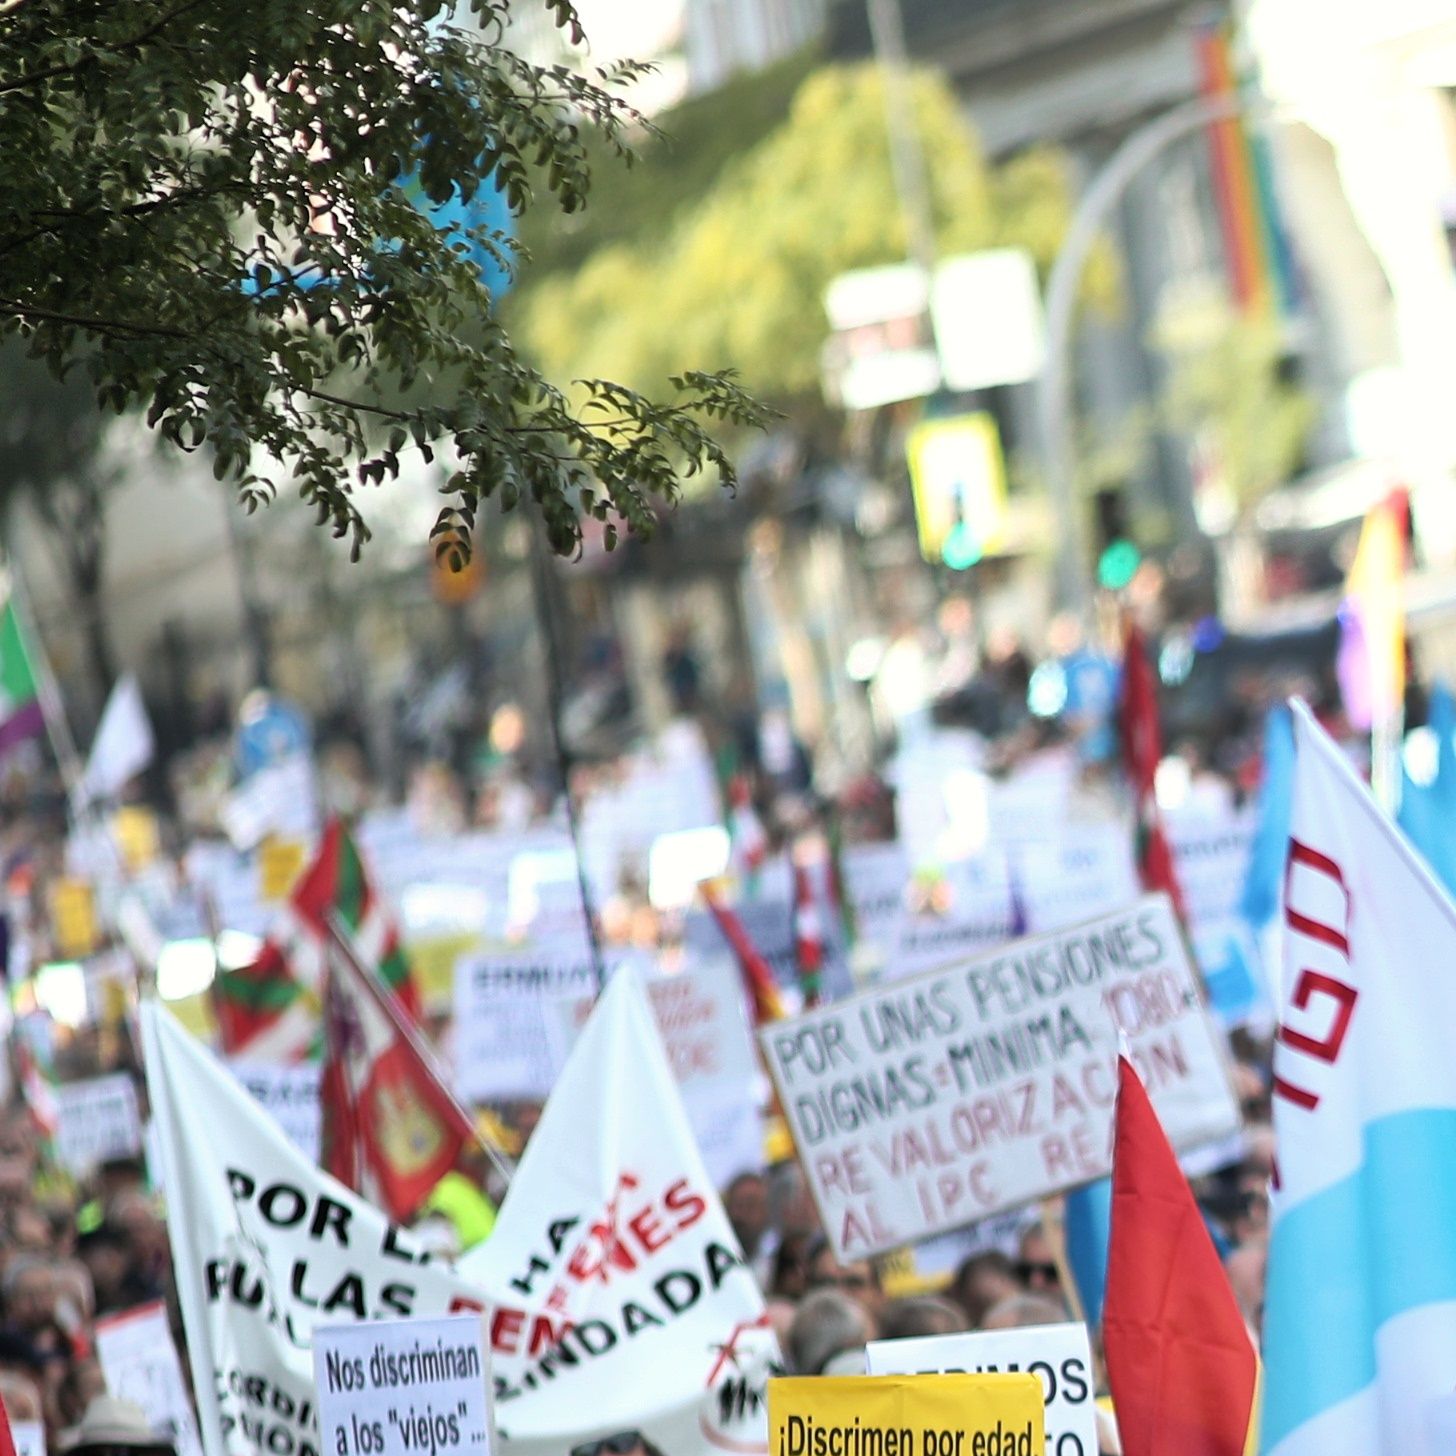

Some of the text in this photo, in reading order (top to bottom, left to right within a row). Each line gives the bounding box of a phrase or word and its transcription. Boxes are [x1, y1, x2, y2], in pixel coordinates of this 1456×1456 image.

[774, 1019, 856, 1085] POR
[859, 977, 962, 1053] UNAS
[967, 913, 1166, 1022] PENSIONES
[226, 1168, 354, 1248] POR
[840, 1202, 897, 1254] AL
[290, 1261, 418, 1322] LAS
[326, 1336, 480, 1394] Nos discriminan
[336, 1423, 349, 1456] a
[351, 1412, 385, 1456] los
